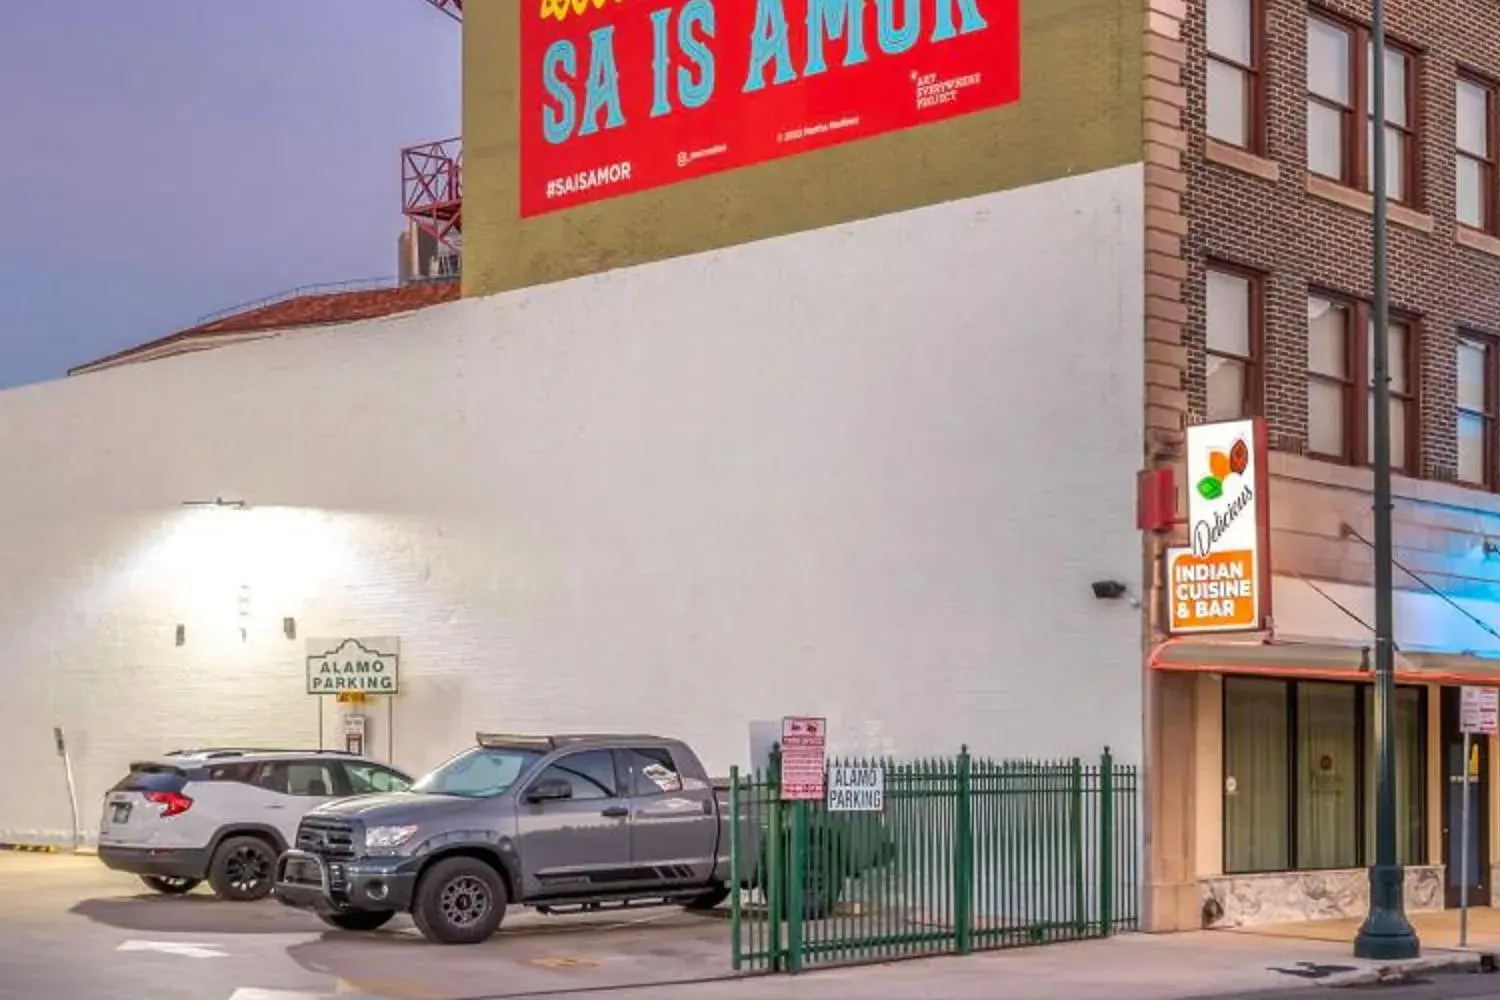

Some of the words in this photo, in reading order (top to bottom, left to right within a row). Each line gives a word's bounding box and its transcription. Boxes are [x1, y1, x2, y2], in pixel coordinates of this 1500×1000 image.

[542, 24, 627, 145] SA
[546, 161, 632, 199] #SAISAMOR
[1193, 483, 1253, 557] Delicious
[1175, 562, 1244, 581] INDIAN
[1176, 580, 1251, 601] CUISINE
[1177, 603, 1189, 618] &
[1196, 600, 1235, 617] BAR
[320, 660, 384, 673] ALAMO
[312, 676, 392, 689] PARKING
[835, 769, 877, 787] ALAMO
[830, 789, 881, 809] PARKING
